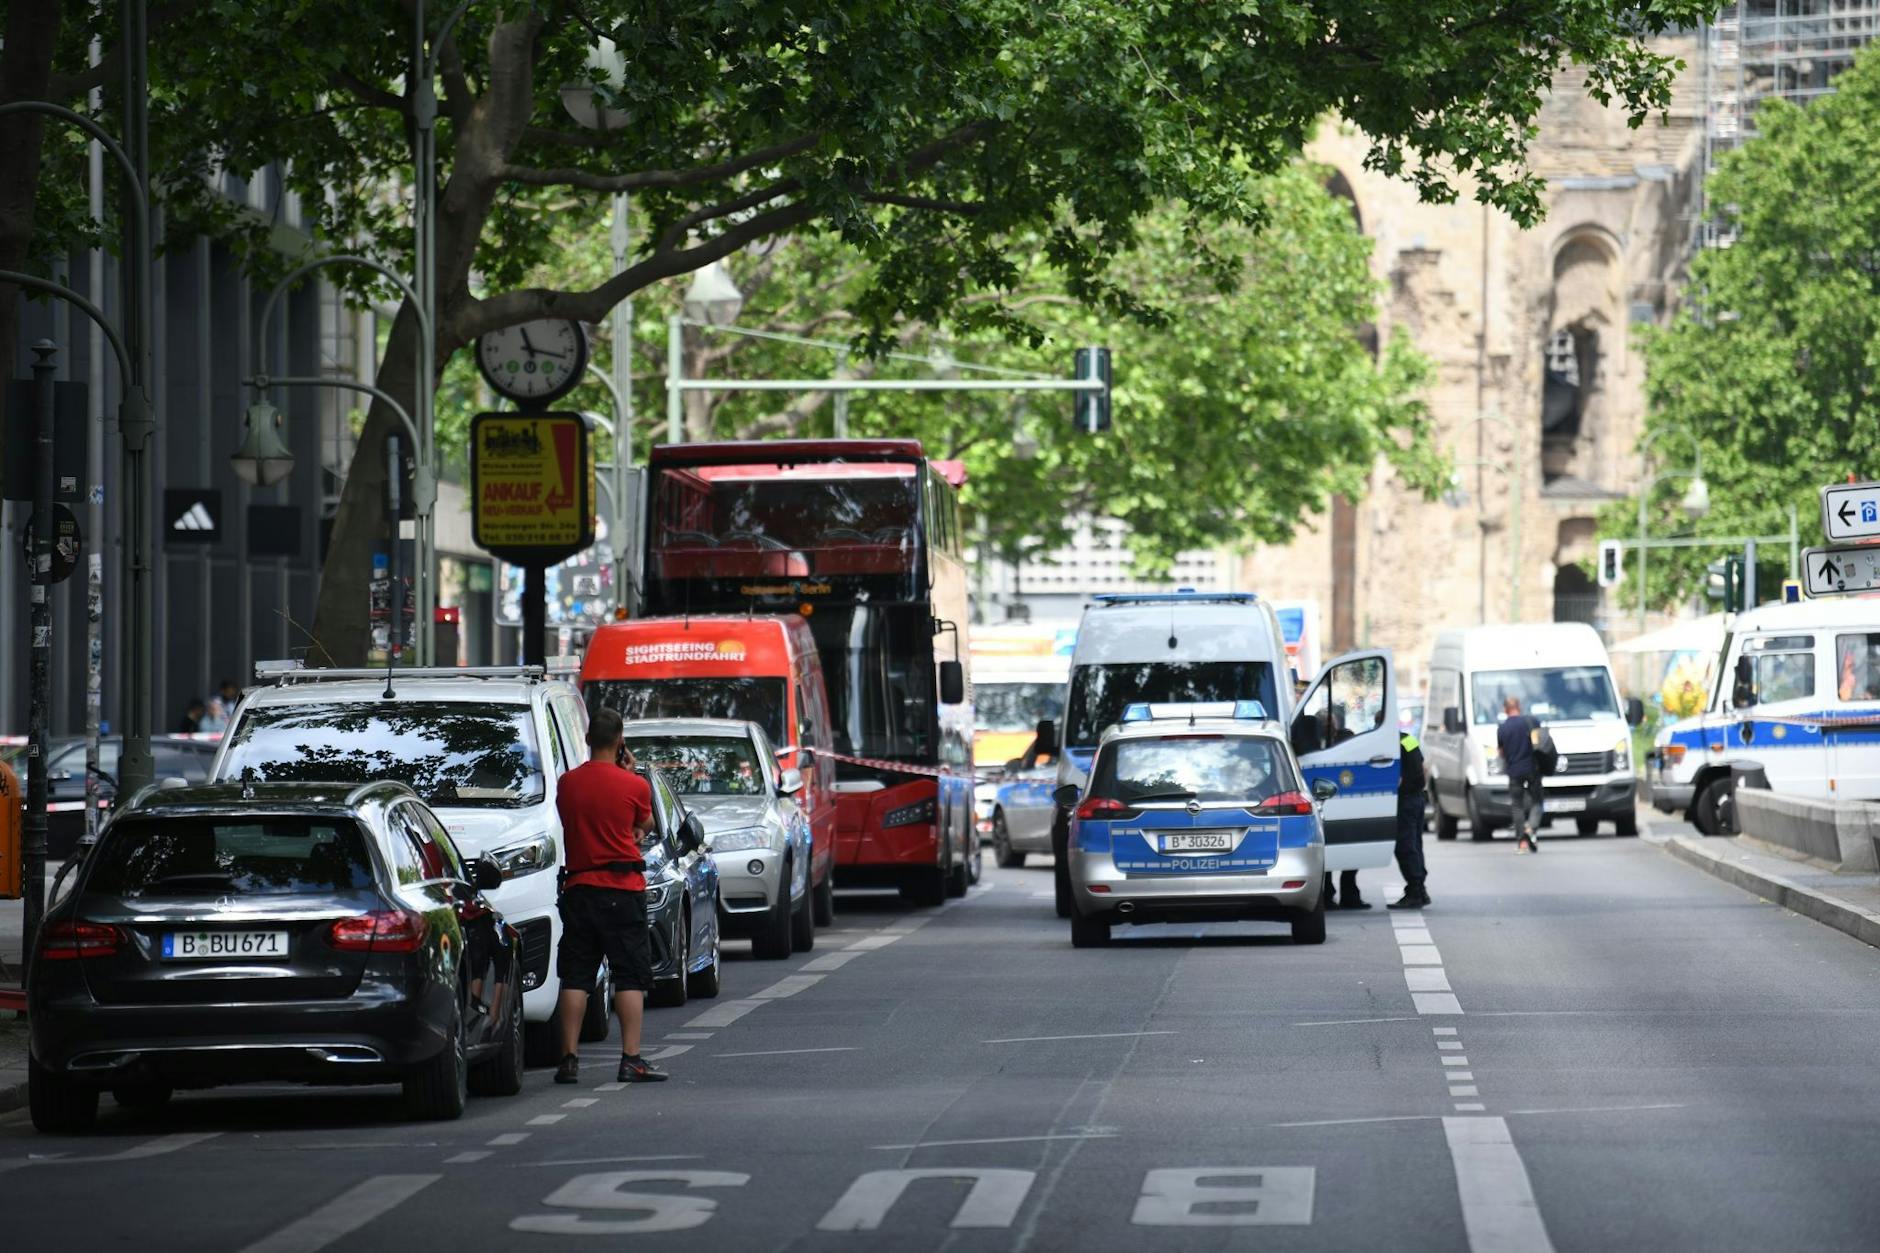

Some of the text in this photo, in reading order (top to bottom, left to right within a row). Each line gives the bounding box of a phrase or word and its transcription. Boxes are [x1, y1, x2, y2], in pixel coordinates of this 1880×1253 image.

[483, 482, 543, 502] ANKAUF
[625, 641, 716, 655] SIGHTSEEING
[625, 652, 747, 665] STADTRUNDFAHRT
[1171, 836, 1225, 848] B 30326
[1171, 859, 1220, 870] POLIZEI
[182, 934, 196, 954] B
[509, 1166, 1316, 1234] BUS
